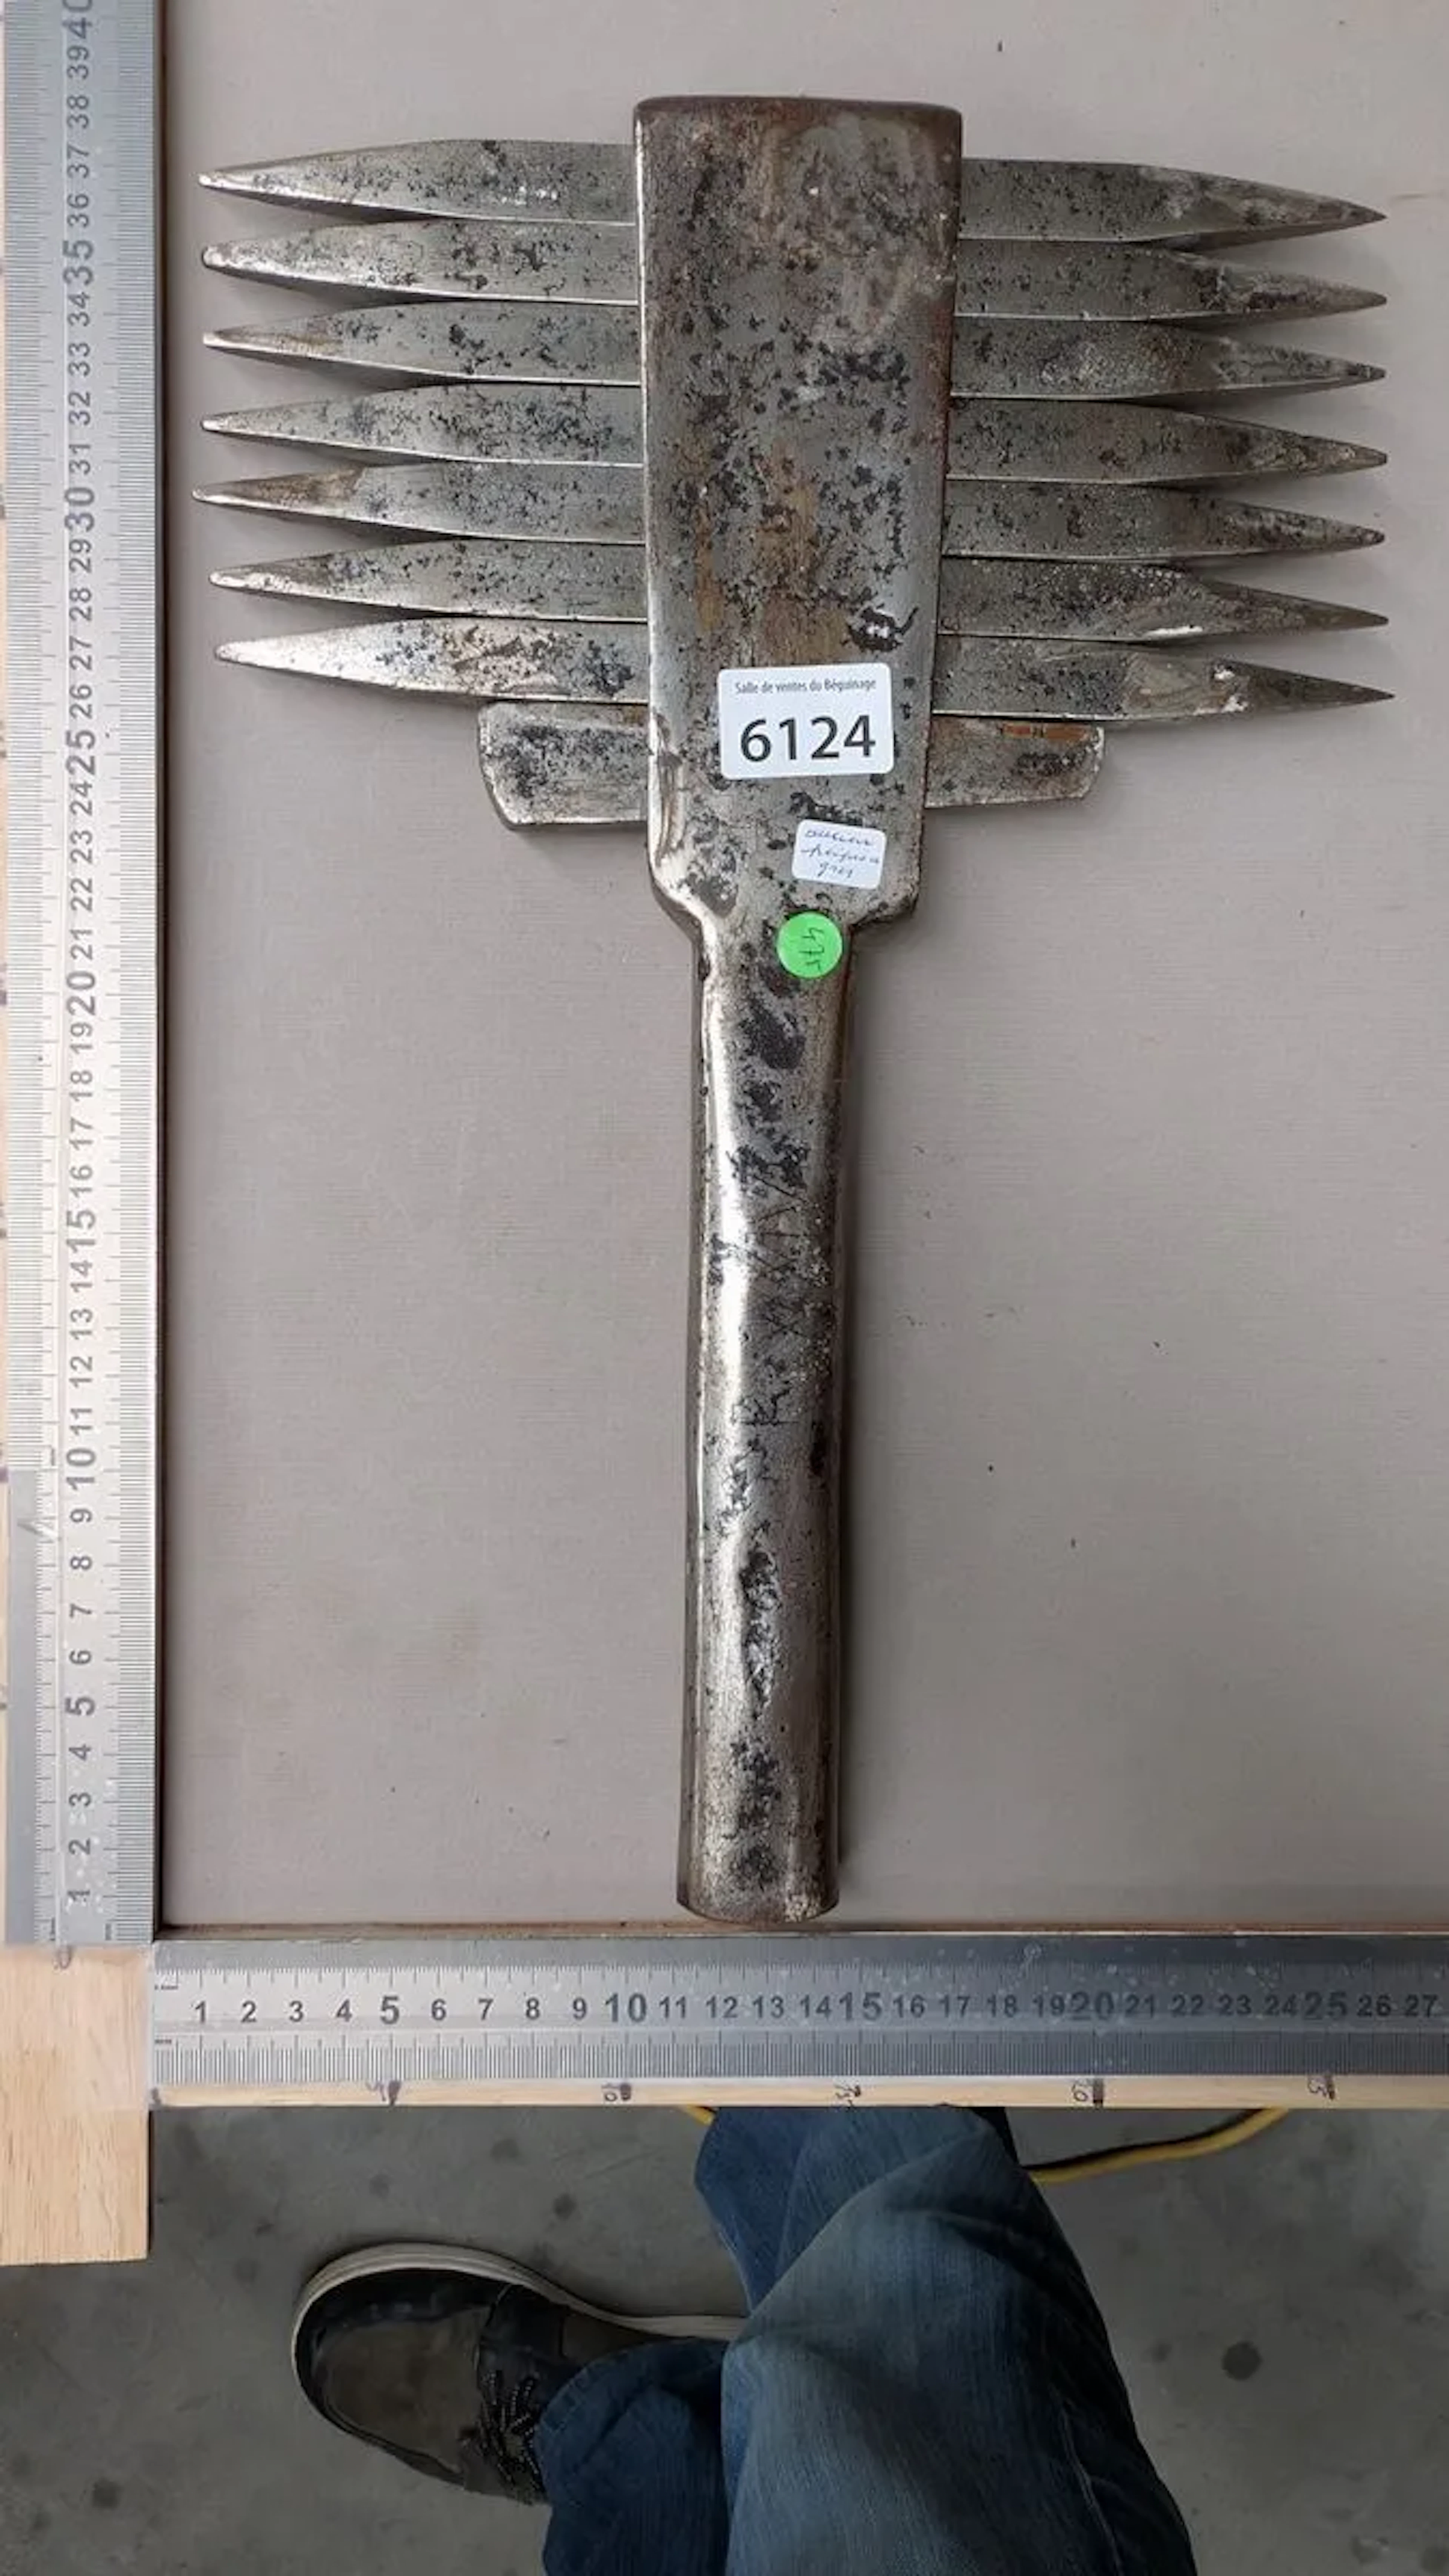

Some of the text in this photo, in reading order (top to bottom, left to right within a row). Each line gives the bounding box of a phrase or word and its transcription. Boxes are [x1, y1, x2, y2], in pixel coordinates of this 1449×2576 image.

[67, 45, 89, 80] 39
[67, 95, 89, 129] 38
[67, 145, 89, 178] 37
[67, 193, 89, 228] 36
[63, 239, 94, 286] 35
[68, 292, 91, 327] 34
[68, 342, 91, 376] 33
[68, 390, 91, 426] 32
[69, 443, 91, 475] 31
[65, 486, 95, 532] 30
[69, 539, 92, 573] 29
[69, 587, 92, 622] 28
[69, 635, 92, 670] 27
[69, 684, 92, 719] 26
[735, 681, 758, 694] Salle
[762, 681, 773, 693] de
[776, 681, 807, 692] ventes
[810, 680, 821, 692] du
[66, 729, 95, 775] 25
[741, 715, 876, 762] 6124
[70, 781, 93, 816] 24
[71, 829, 92, 864] 23
[71, 878, 92, 912] 22
[71, 928, 93, 960] 21
[66, 971, 96, 1016] 20
[71, 1022, 93, 1055] 19
[71, 1069, 93, 1102] 18
[71, 1118, 93, 1150] 17
[70, 1164, 93, 1198] 16
[66, 1210, 96, 1254] 15
[70, 1259, 92, 1293] 14
[71, 1308, 93, 1340] 13
[70, 1356, 93, 1389] 12
[71, 1407, 92, 1436] 11
[66, 1448, 96, 1491] 10
[70, 1509, 93, 1524] 9
[71, 1555, 92, 1571] 8
[70, 1603, 92, 1619] 7
[69, 1649, 92, 1666] 6
[65, 1696, 95, 1716] 5
[69, 1744, 91, 1761] 4
[69, 1792, 92, 1808] 3
[69, 1838, 91, 1855] 2
[68, 1889, 91, 1902] 1
[195, 1991, 1438, 2024] 1 2 3 4 5 6 7 8 9 10 11 12 13 14 15 16 17 18 19 20 21 22 23 24 25 26 27
